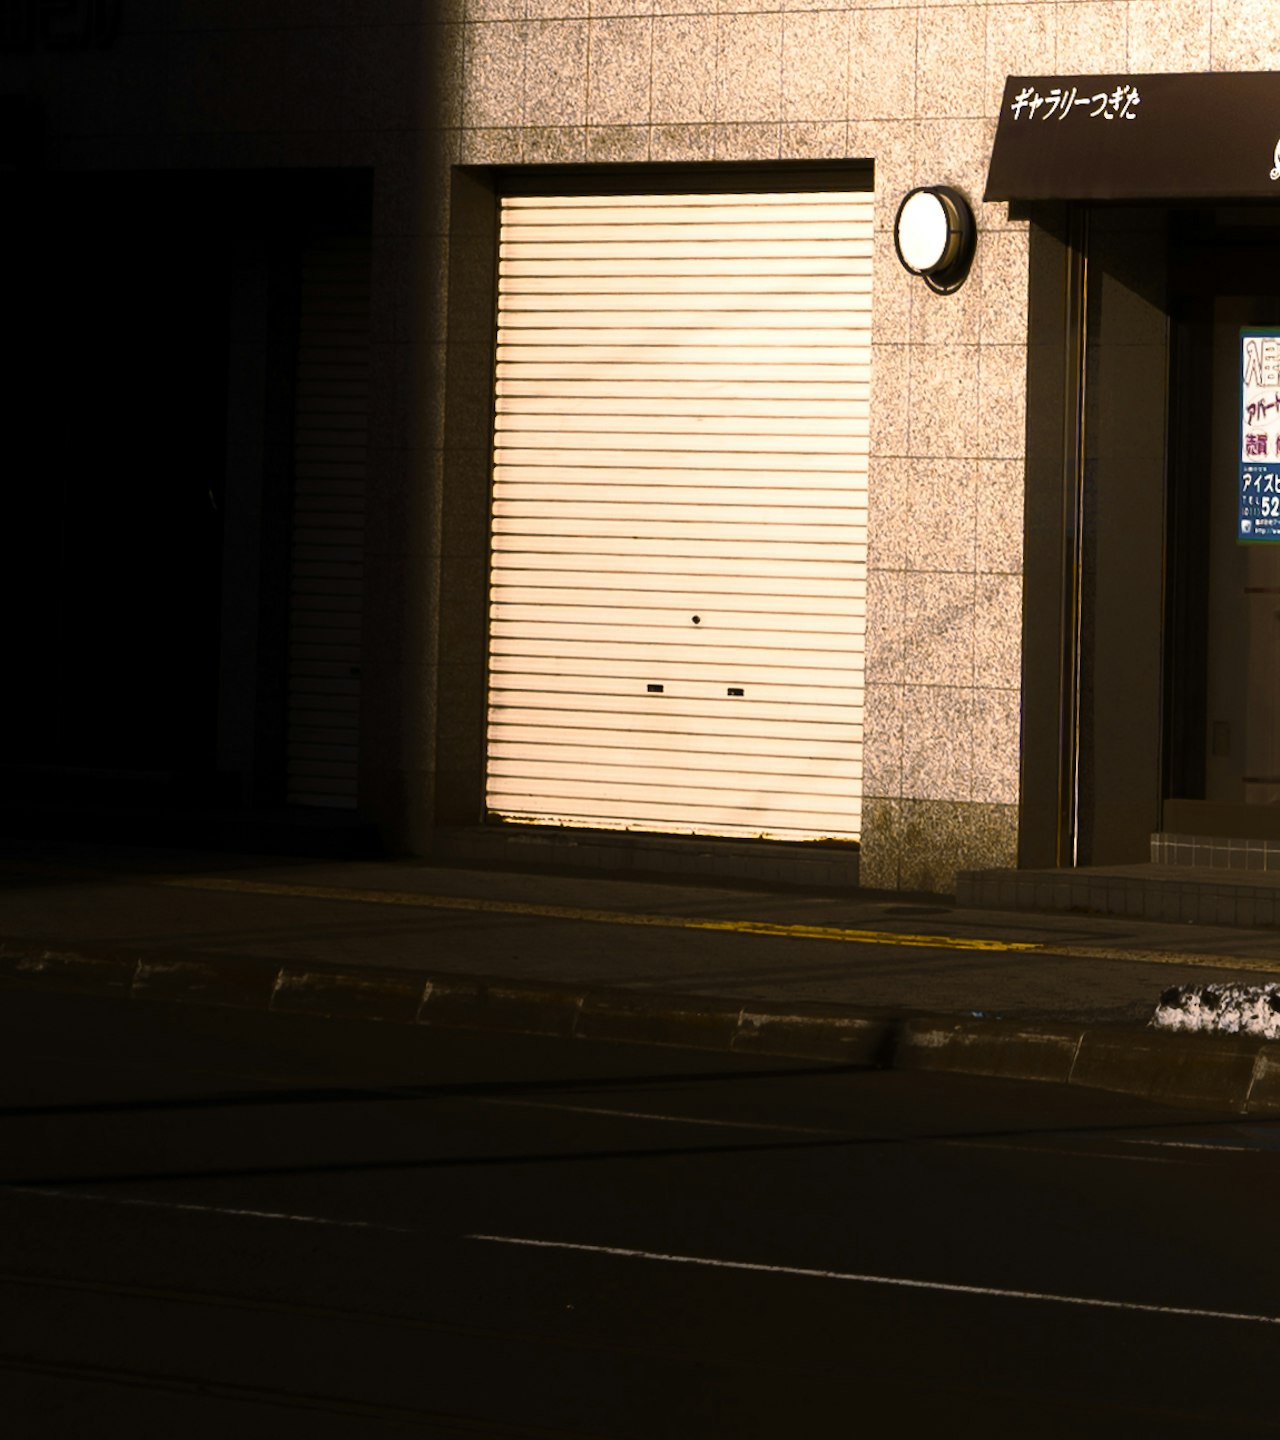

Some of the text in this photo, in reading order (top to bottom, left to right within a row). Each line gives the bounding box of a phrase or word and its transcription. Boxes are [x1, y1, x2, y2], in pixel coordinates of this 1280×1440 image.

[1011, 85, 1141, 120] ギャラリーつぎた
